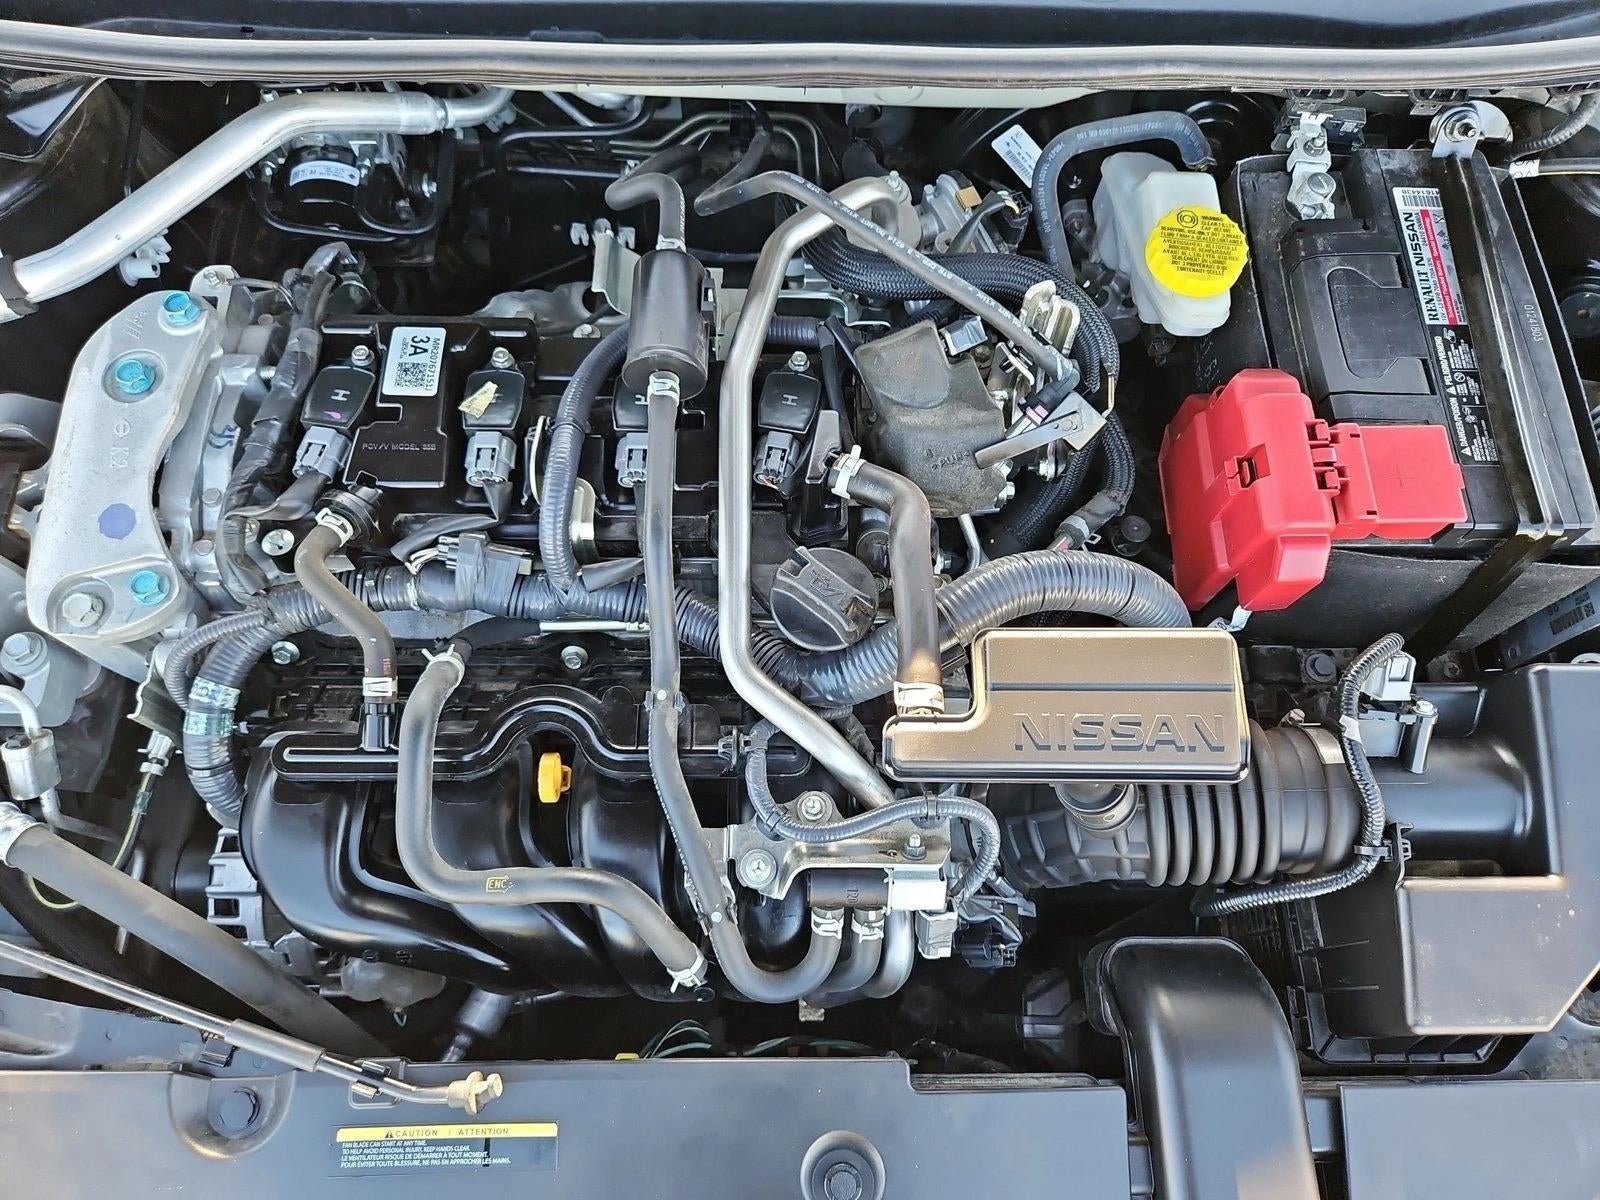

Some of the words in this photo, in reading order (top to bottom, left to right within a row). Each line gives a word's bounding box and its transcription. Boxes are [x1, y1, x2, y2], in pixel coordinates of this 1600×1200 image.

[1403, 212, 1425, 266] NISSAN
[1417, 270, 1439, 321] RENAULT
[1524, 304, 1543, 341] 01241803
[409, 335, 430, 356] 3A
[1450, 398, 1468, 446] DANGER/POISON
[1013, 713, 1225, 751] NISSAN
